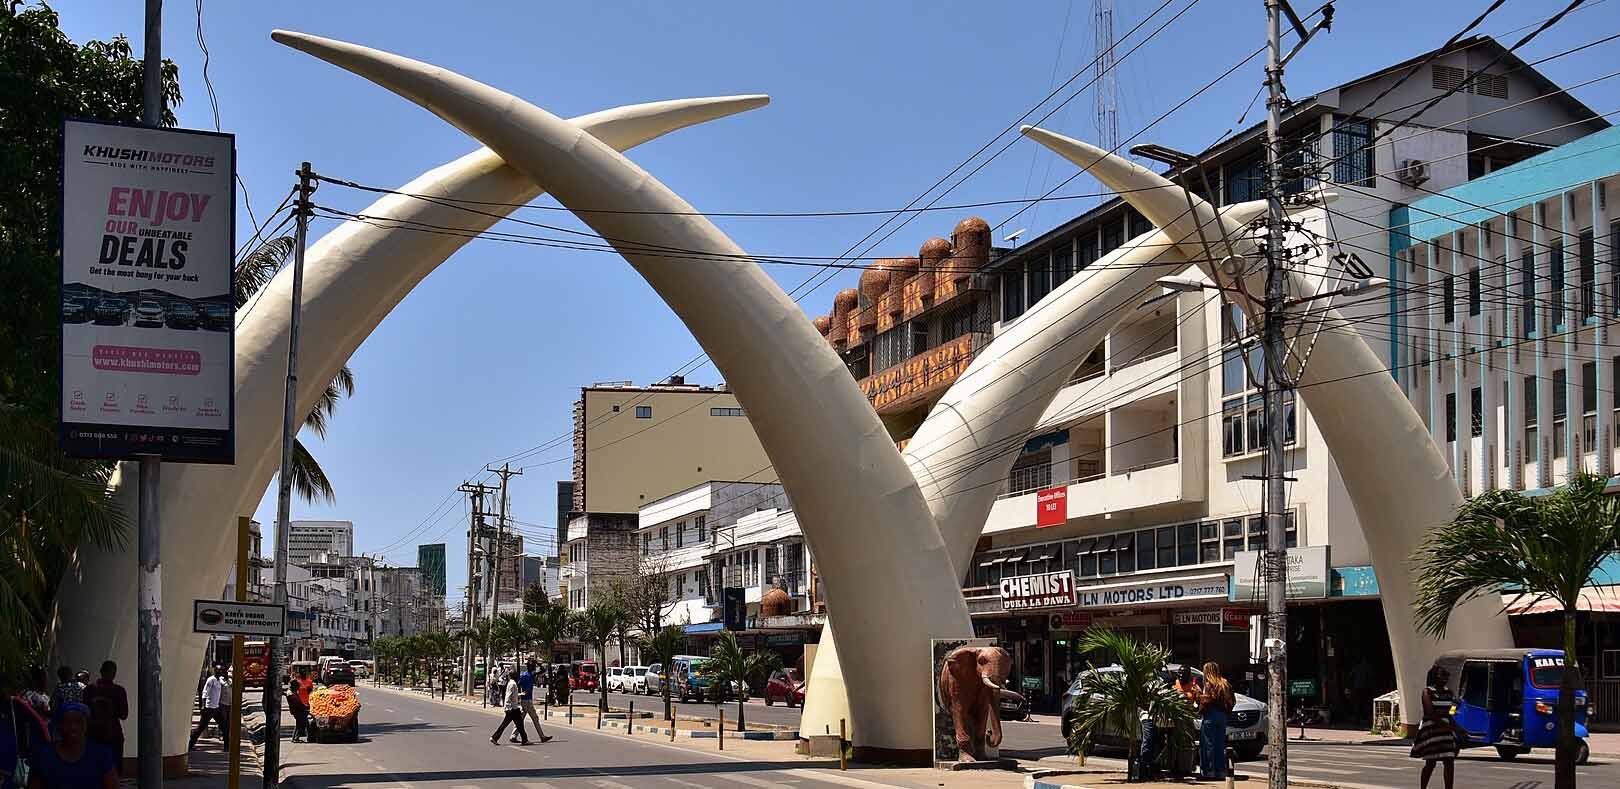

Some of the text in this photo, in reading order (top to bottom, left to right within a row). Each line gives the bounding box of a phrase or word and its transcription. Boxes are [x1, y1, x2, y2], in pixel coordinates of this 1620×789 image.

[107, 187, 209, 226] ENJOY
[105, 220, 193, 241] OUR UNBEATABLE
[98, 235, 188, 270] DEALS
[89, 266, 102, 275] Get
[103, 268, 116, 276] the
[153, 271, 164, 279] for
[165, 273, 182, 281] your
[1001, 572, 1070, 598] CHEMIST
[1004, 595, 1071, 609] DUKA LA DAWA
[1083, 592, 1099, 606] LN
[1103, 588, 1154, 604] MOTORS
[1159, 585, 1184, 600] LTD
[246, 619, 280, 627] AUTHORITY
[1182, 614, 1191, 623] LN
[1191, 613, 1220, 623] MOTORS
[1534, 658, 1555, 668] KAA
